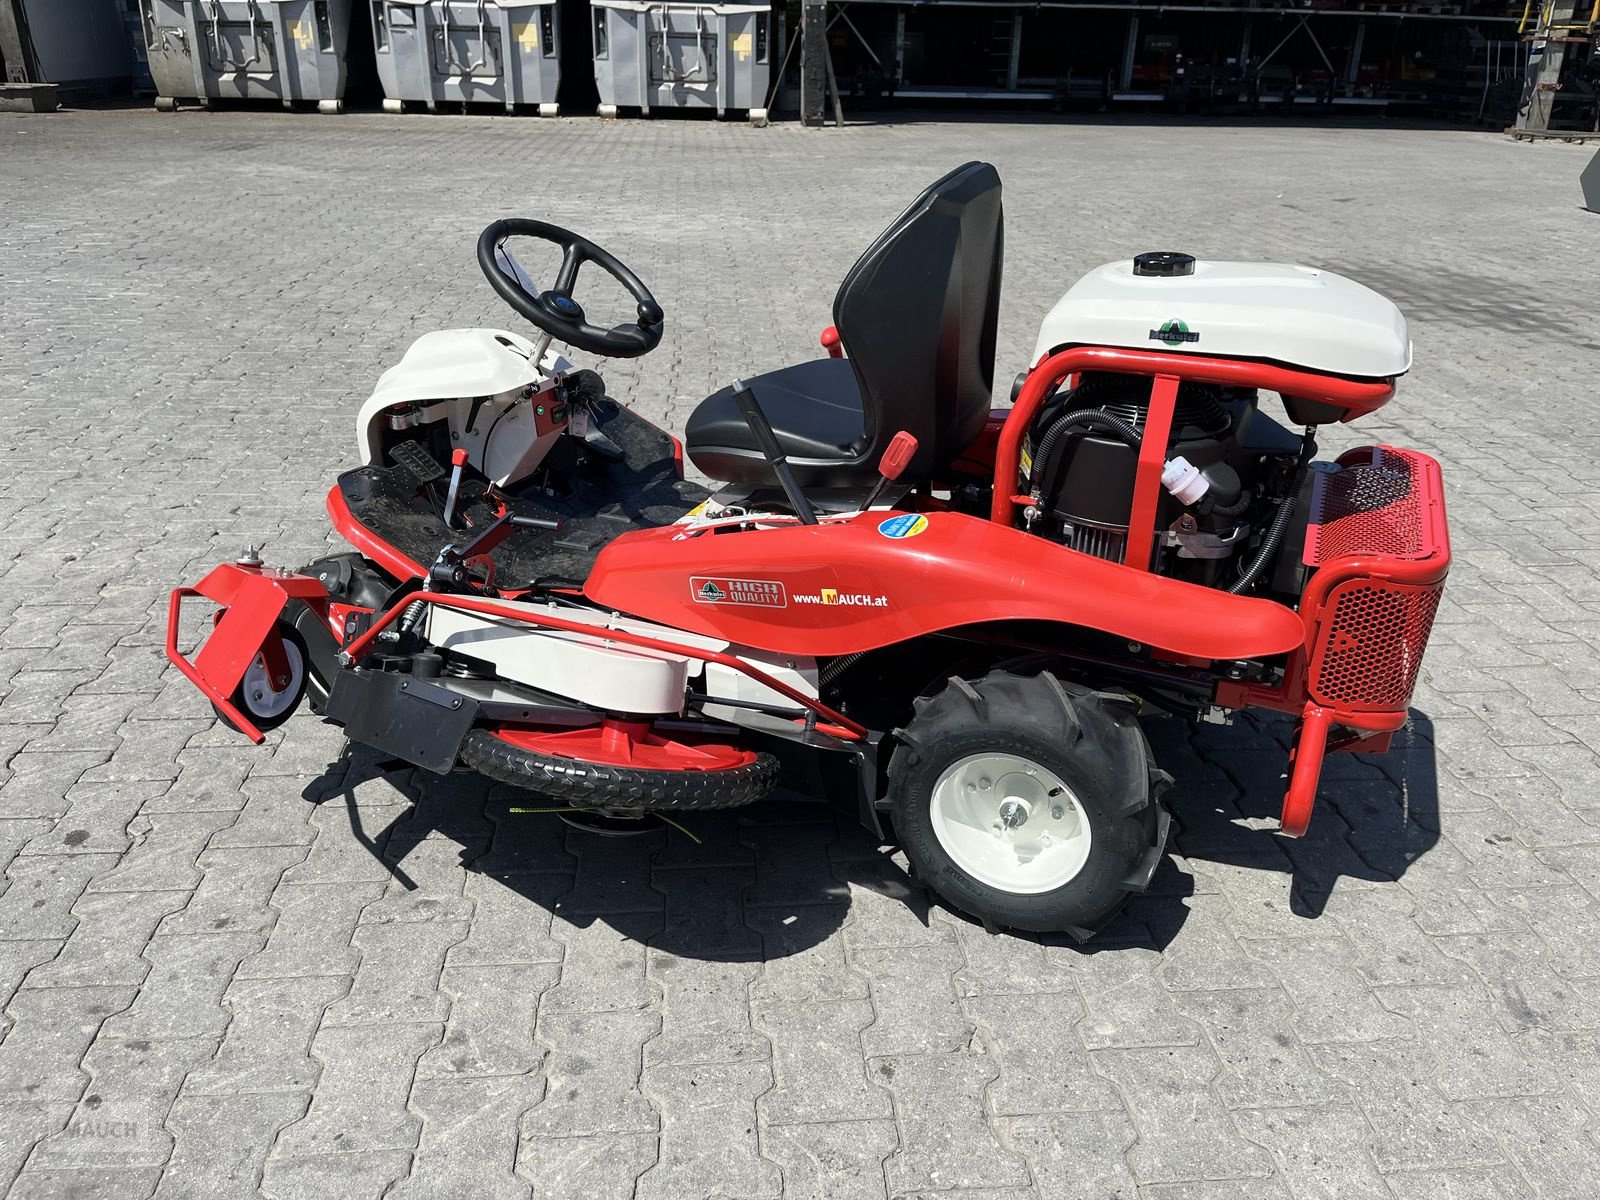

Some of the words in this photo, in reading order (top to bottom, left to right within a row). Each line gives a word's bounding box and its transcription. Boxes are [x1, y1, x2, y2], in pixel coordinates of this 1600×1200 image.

[728, 581, 778, 593] HIGH
[730, 591, 778, 604] QUALITY
[793, 593, 888, 607] www.MAUCH.at
